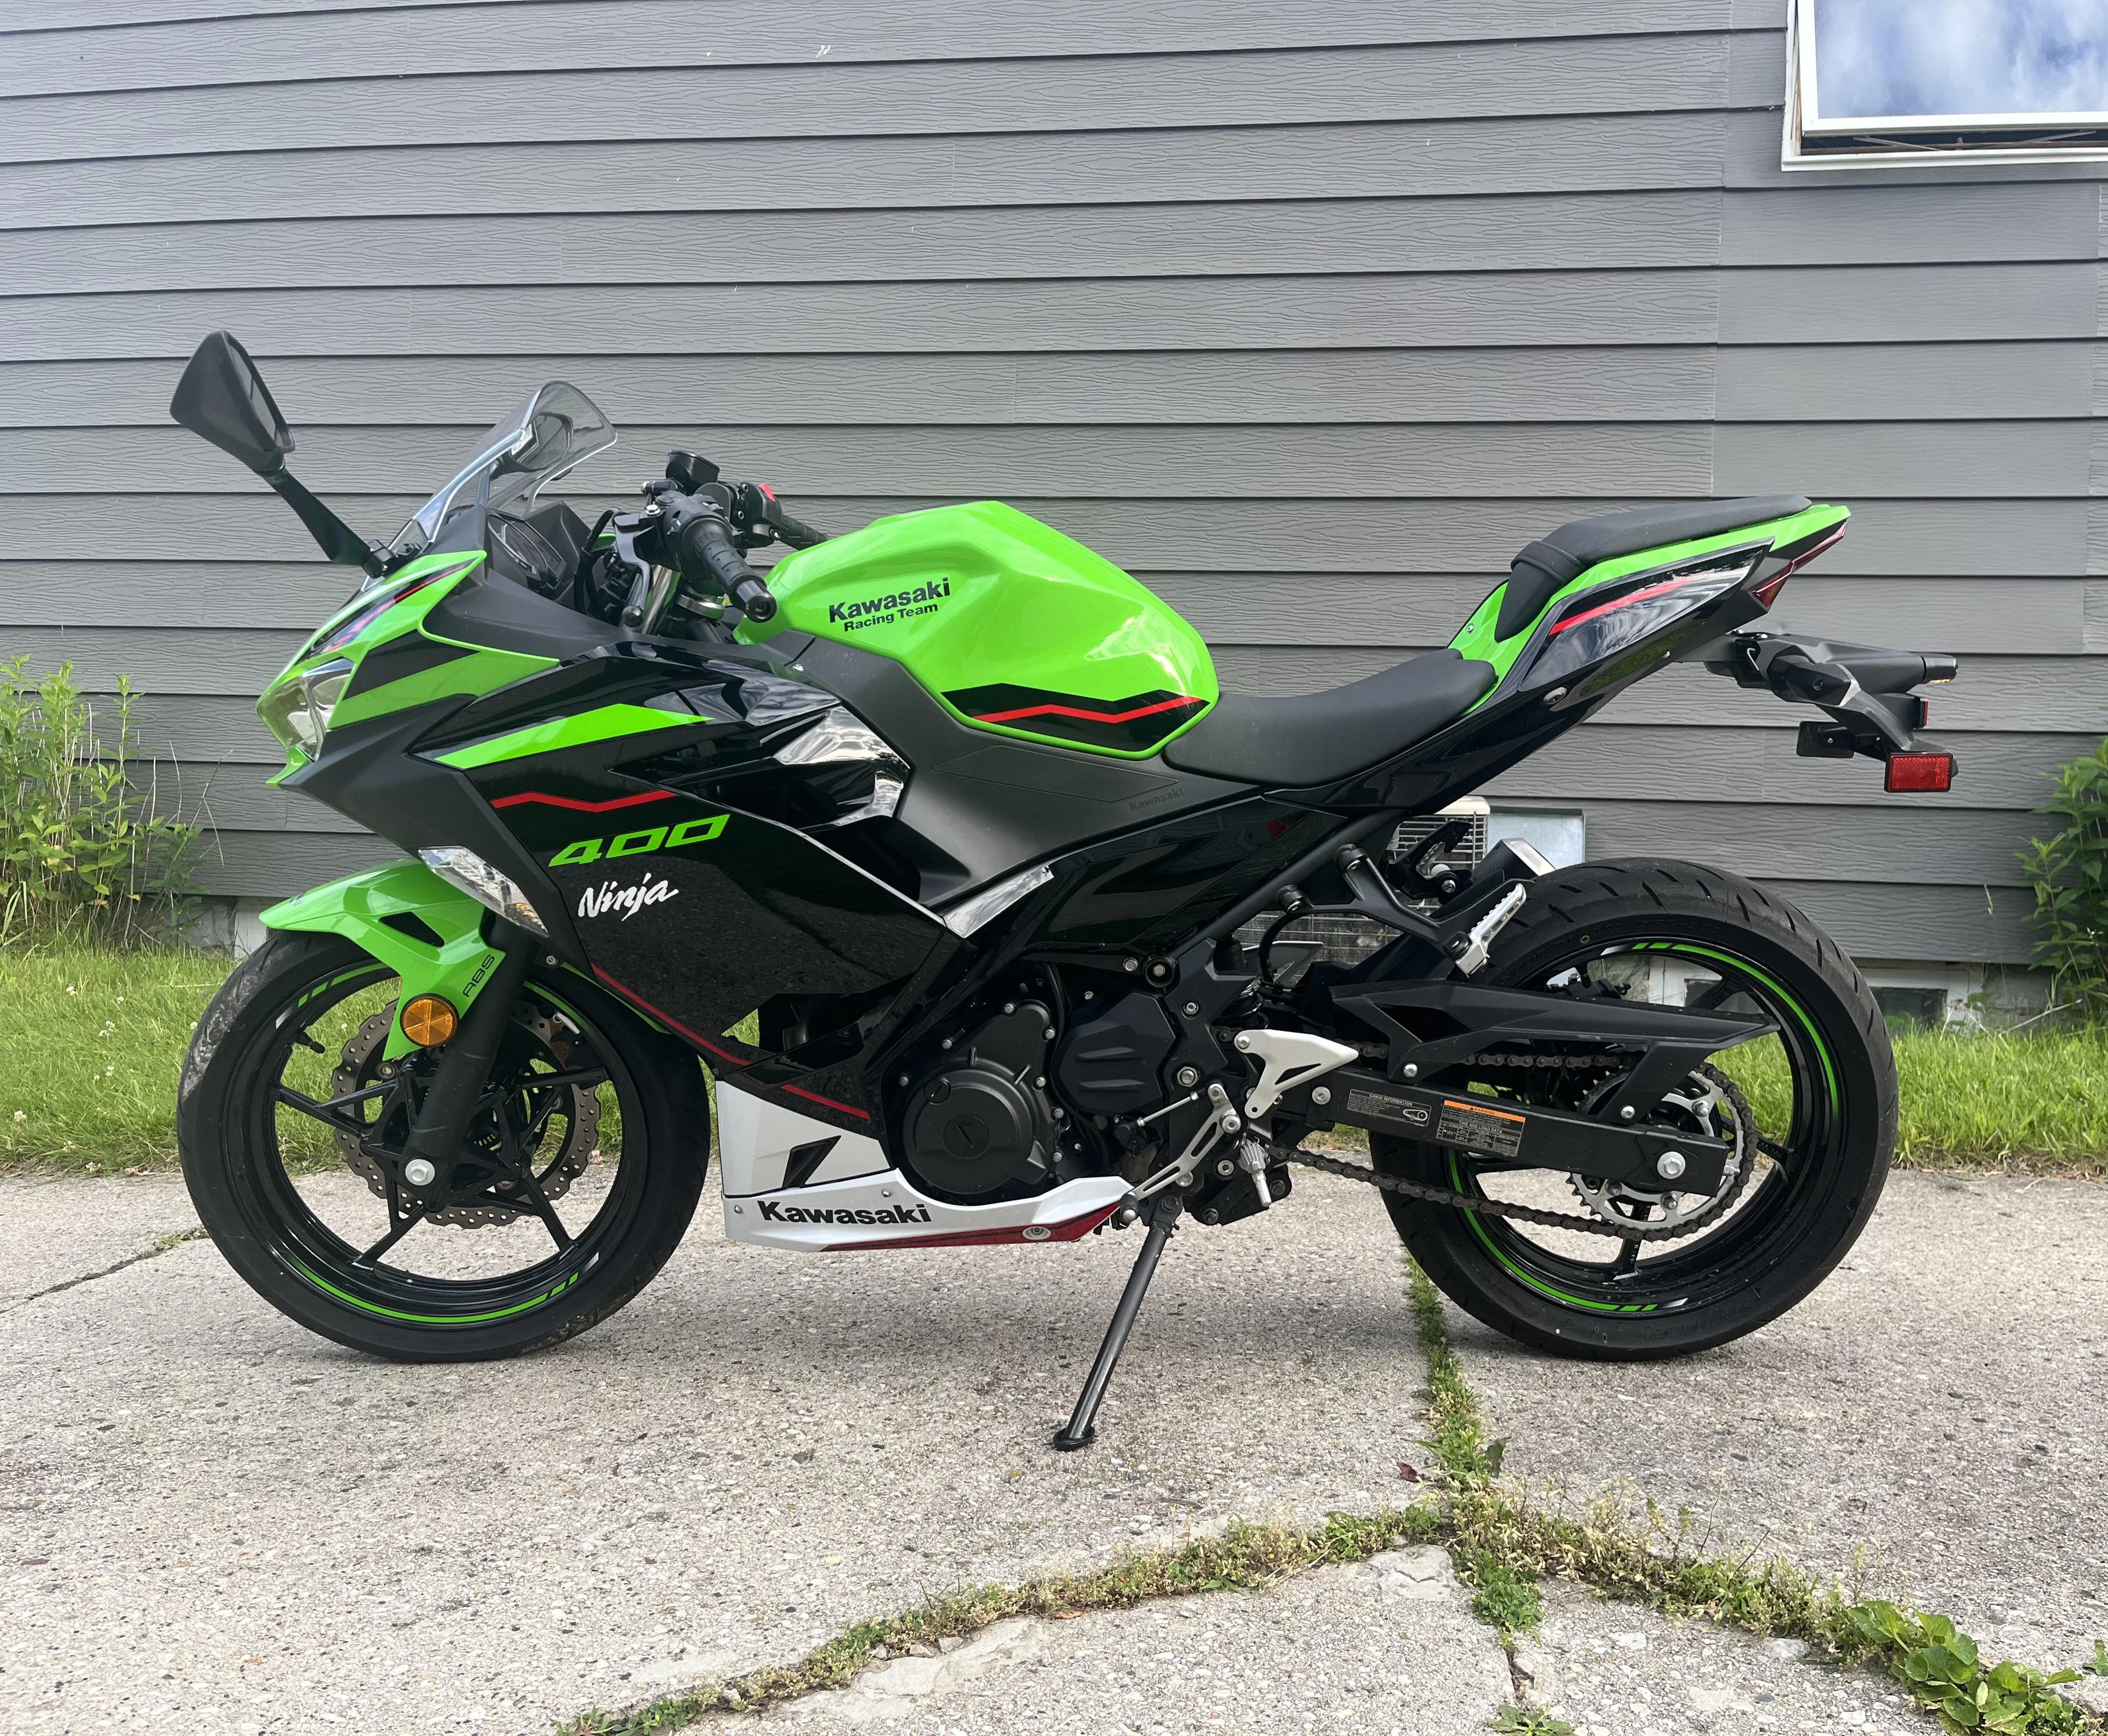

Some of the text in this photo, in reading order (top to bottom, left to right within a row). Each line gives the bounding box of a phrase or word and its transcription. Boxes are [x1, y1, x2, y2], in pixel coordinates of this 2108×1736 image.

[829, 577, 950, 623] Kawasaki
[844, 604, 938, 632] Racing Team
[1129, 787, 1184, 811] Kawasaki
[548, 814, 730, 867] 400
[578, 872, 679, 922] Ninja
[462, 954, 494, 997] ABS
[1383, 1097, 1413, 1106] INFORMATION
[757, 1200, 932, 1224] Kawasaki
